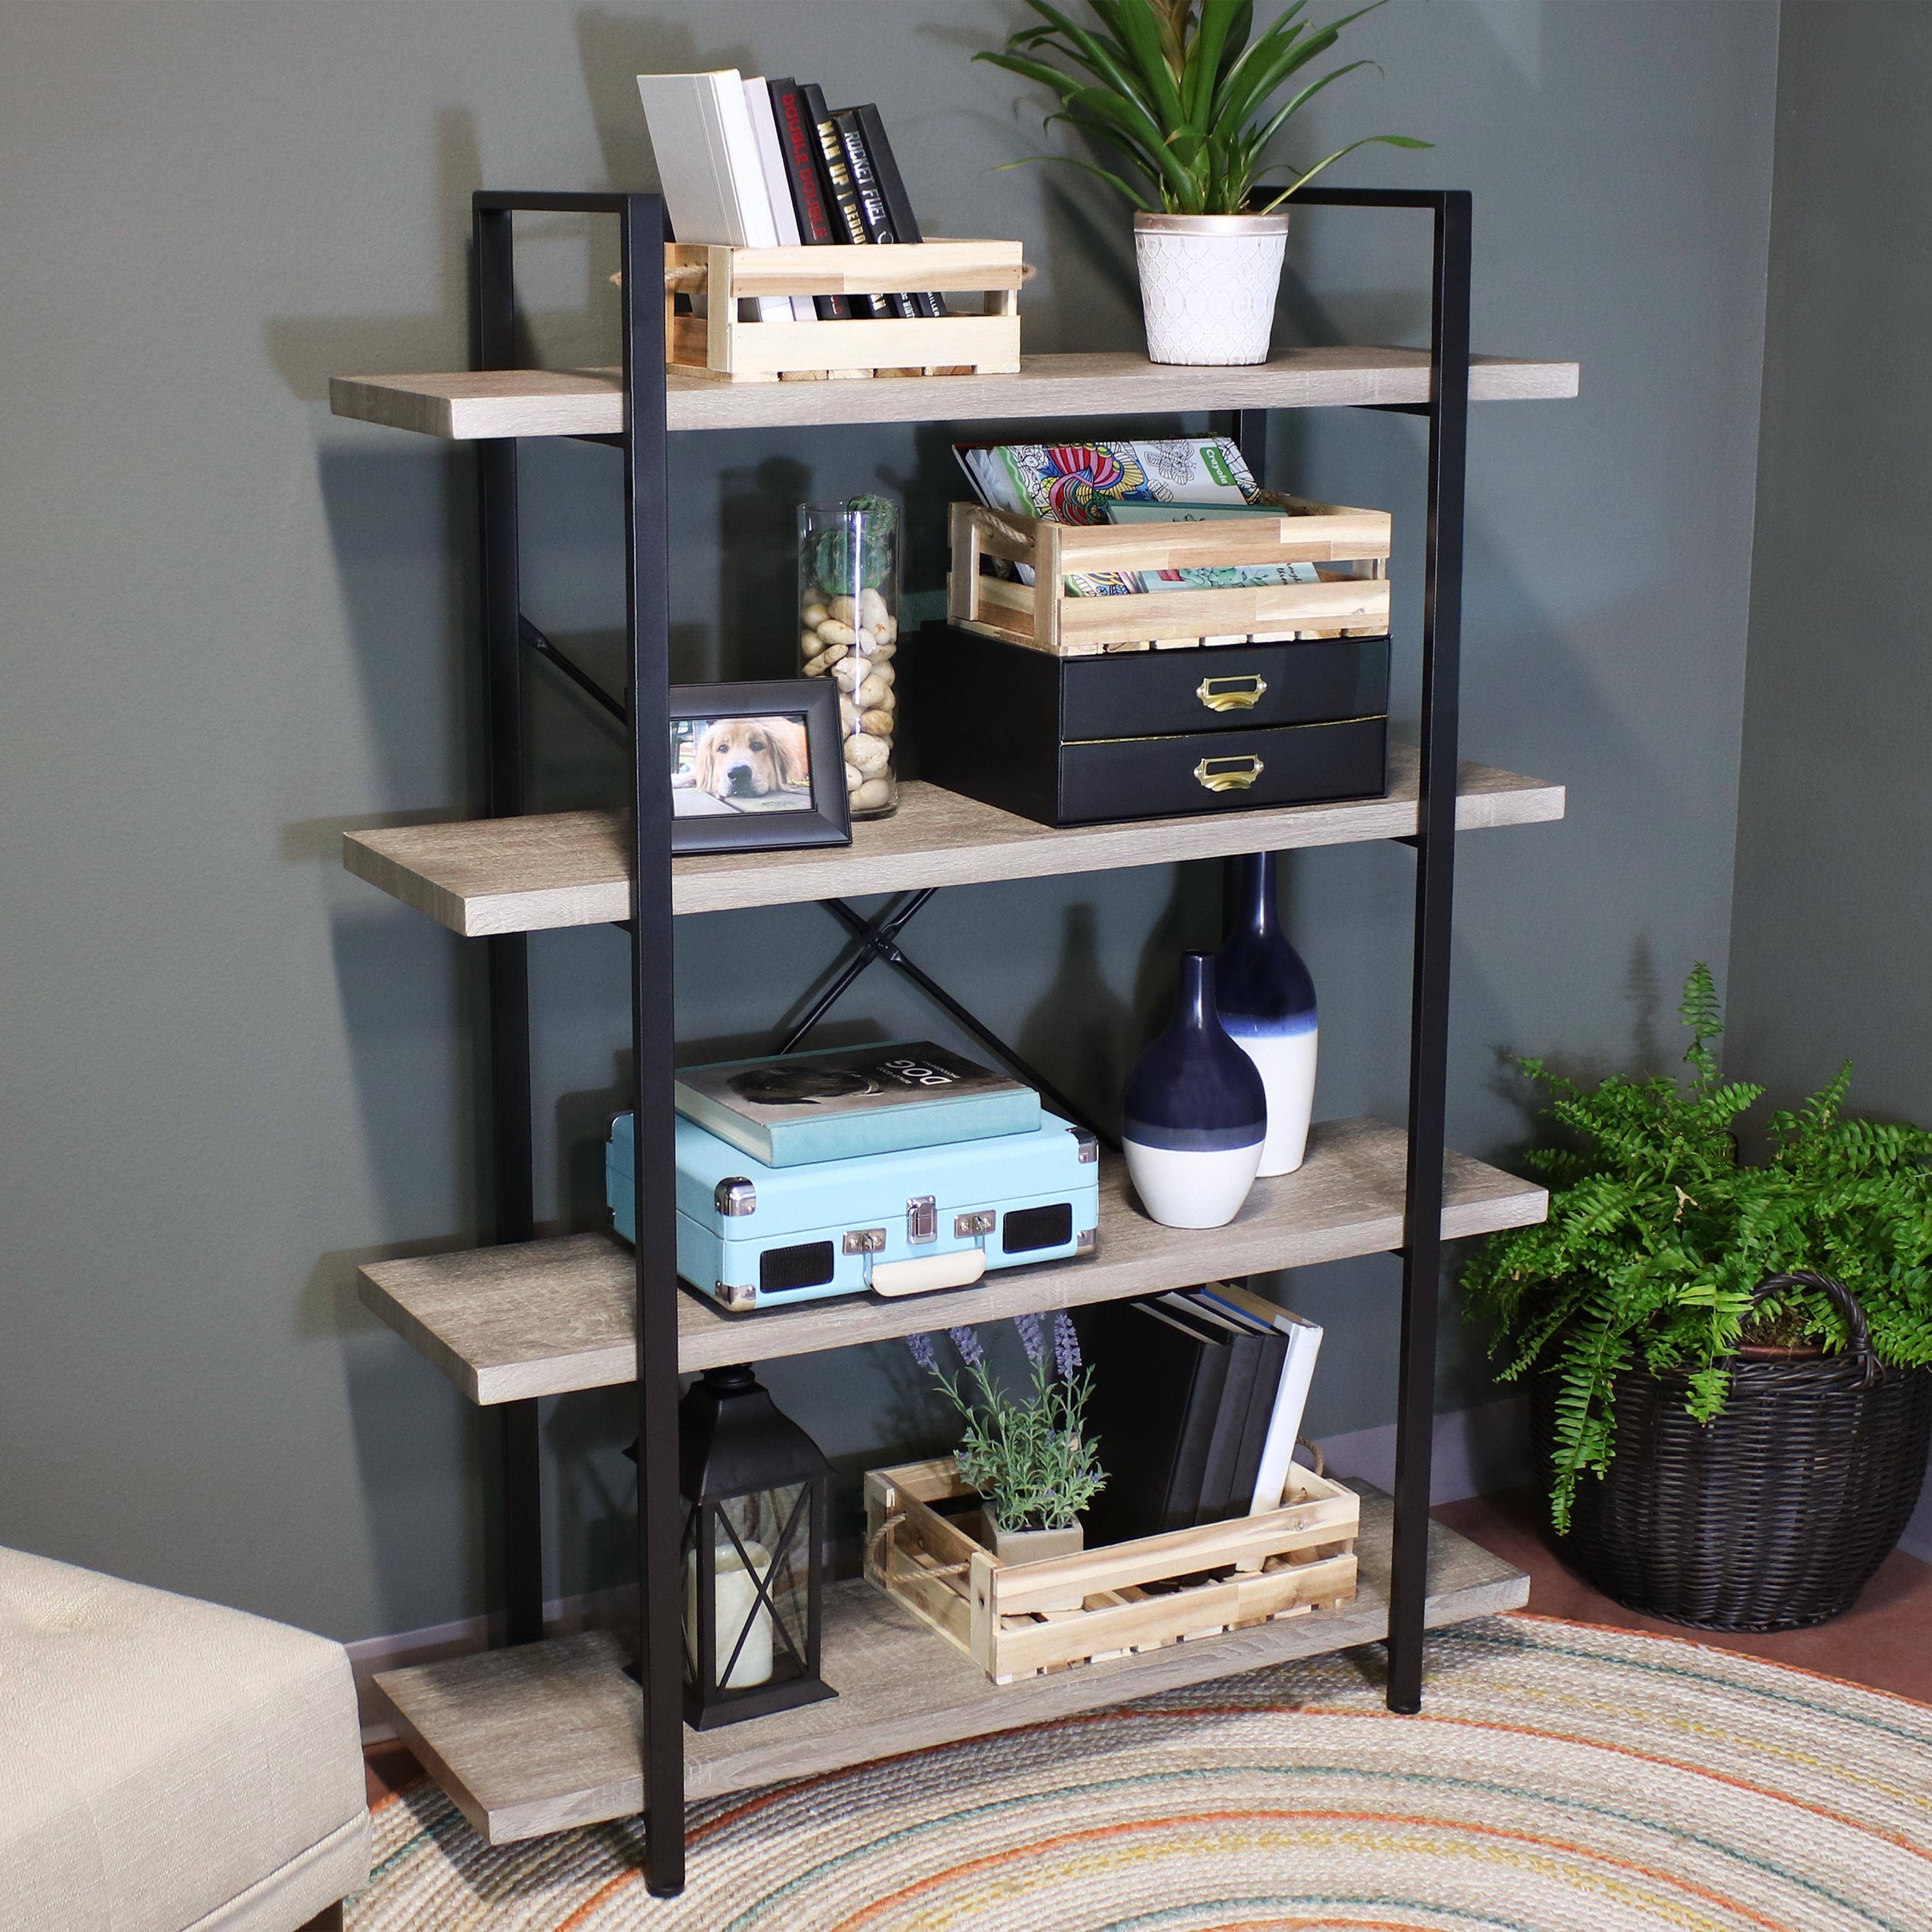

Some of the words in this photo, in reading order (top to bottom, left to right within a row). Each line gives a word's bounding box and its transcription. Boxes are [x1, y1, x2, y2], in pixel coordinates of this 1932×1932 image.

[782, 93, 809, 166] DOUBLE
[799, 169, 827, 240] DOUBLE
[817, 120, 841, 161] MAN
[829, 163, 849, 185] UP
[844, 204, 867, 245] BEDRO
[844, 131, 875, 184] ROCKET
[863, 189, 886, 225] FUEL
[1206, 449, 1227, 484] Crayola
[885, 1060, 953, 1085] DOG
